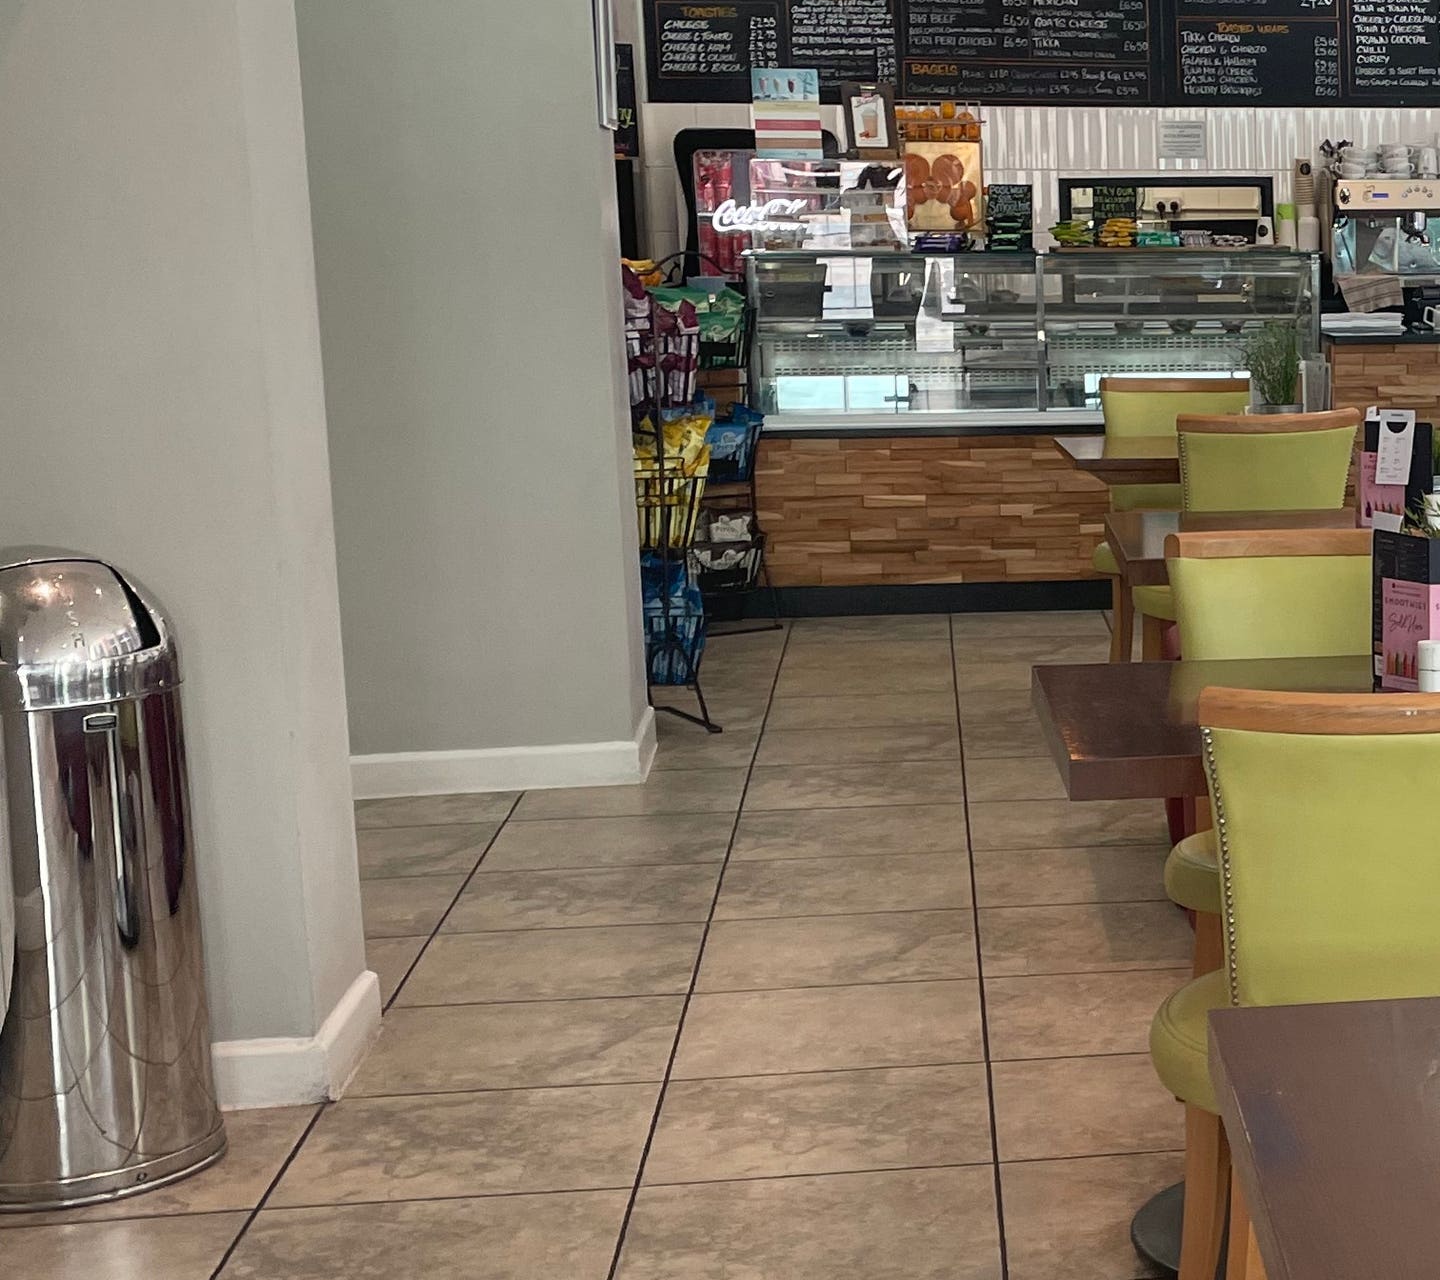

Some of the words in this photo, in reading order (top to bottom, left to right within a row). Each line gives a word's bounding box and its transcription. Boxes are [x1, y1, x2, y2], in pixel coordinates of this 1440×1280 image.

[1355, 25, 1378, 33] TUNA
[1389, 25, 1425, 33] CHEESE
[1033, 38, 1060, 48] TIKKA
[1391, 35, 1431, 44] COCKTAIL
